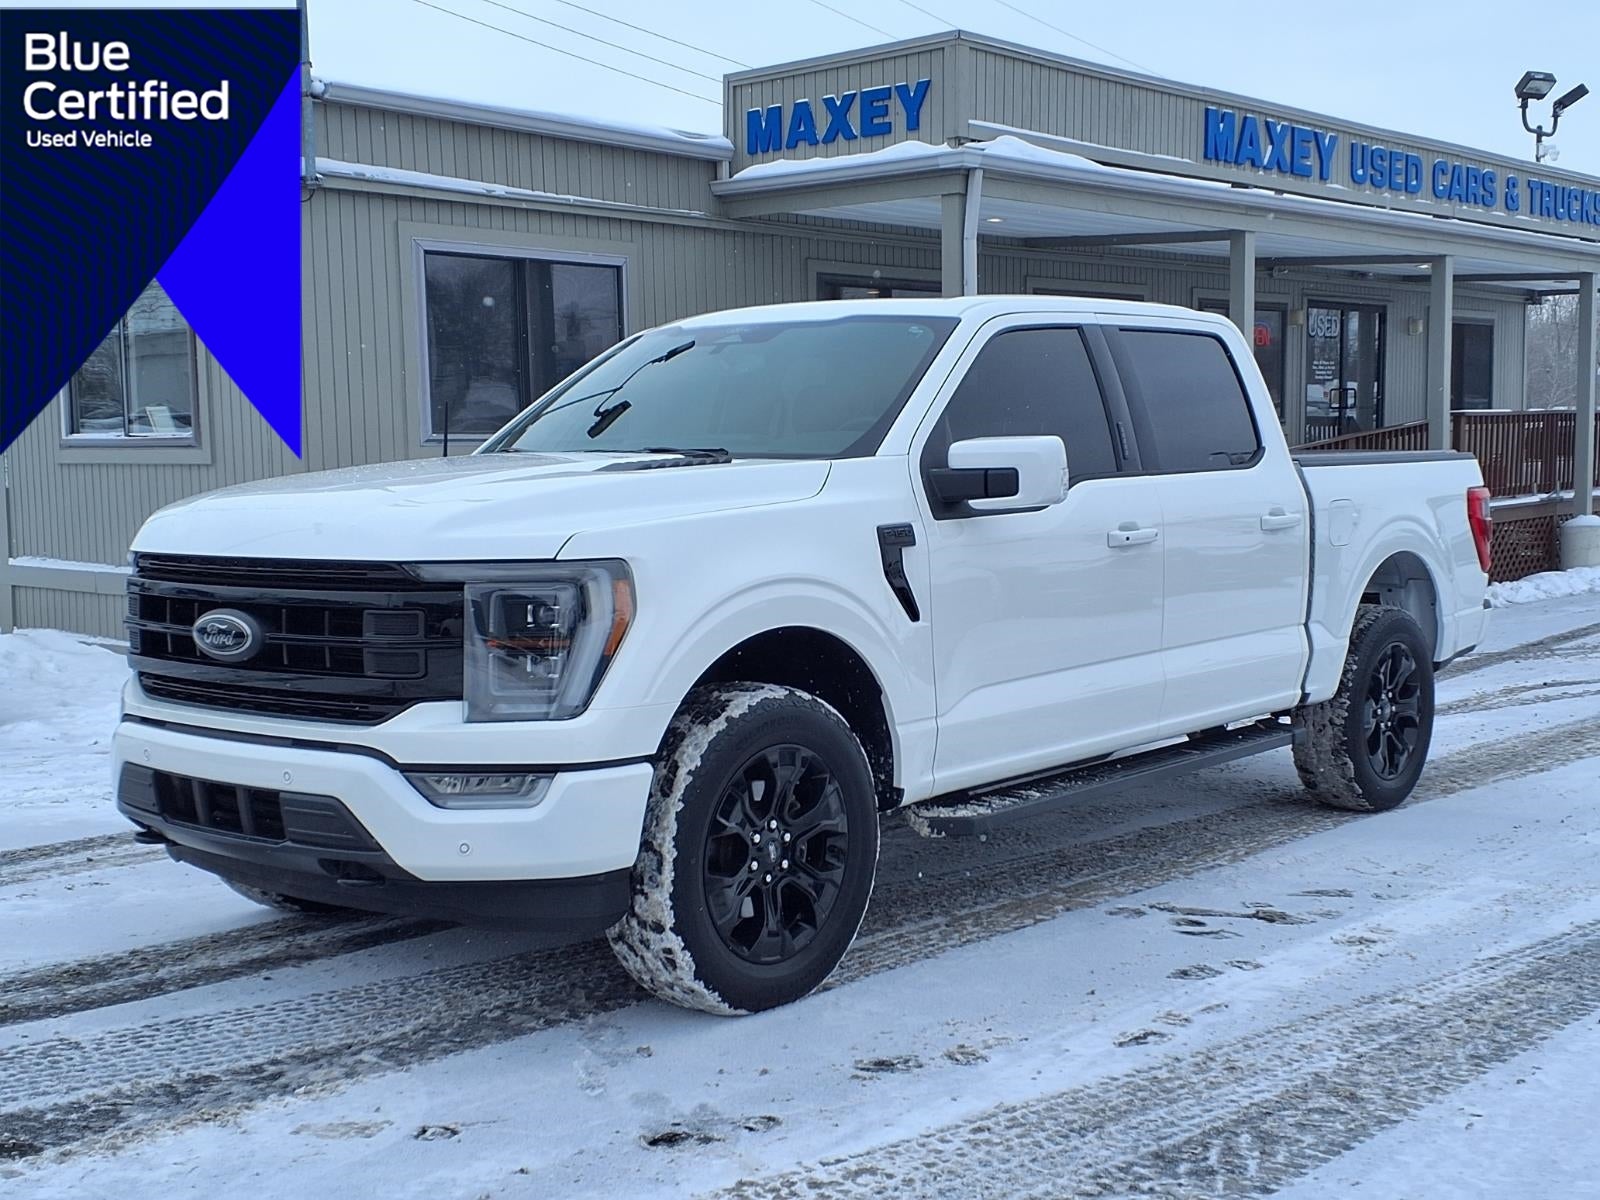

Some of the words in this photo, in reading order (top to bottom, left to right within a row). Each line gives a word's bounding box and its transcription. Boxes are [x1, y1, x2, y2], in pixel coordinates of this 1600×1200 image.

[747, 79, 931, 155] MAXEY
[1204, 106, 1338, 180] MAXEY
[1351, 140, 1423, 194] USED
[1432, 159, 1497, 207] CARS
[1505, 175, 1519, 211] &
[1308, 313, 1339, 337] USED
[203, 622, 236, 646] Ford
